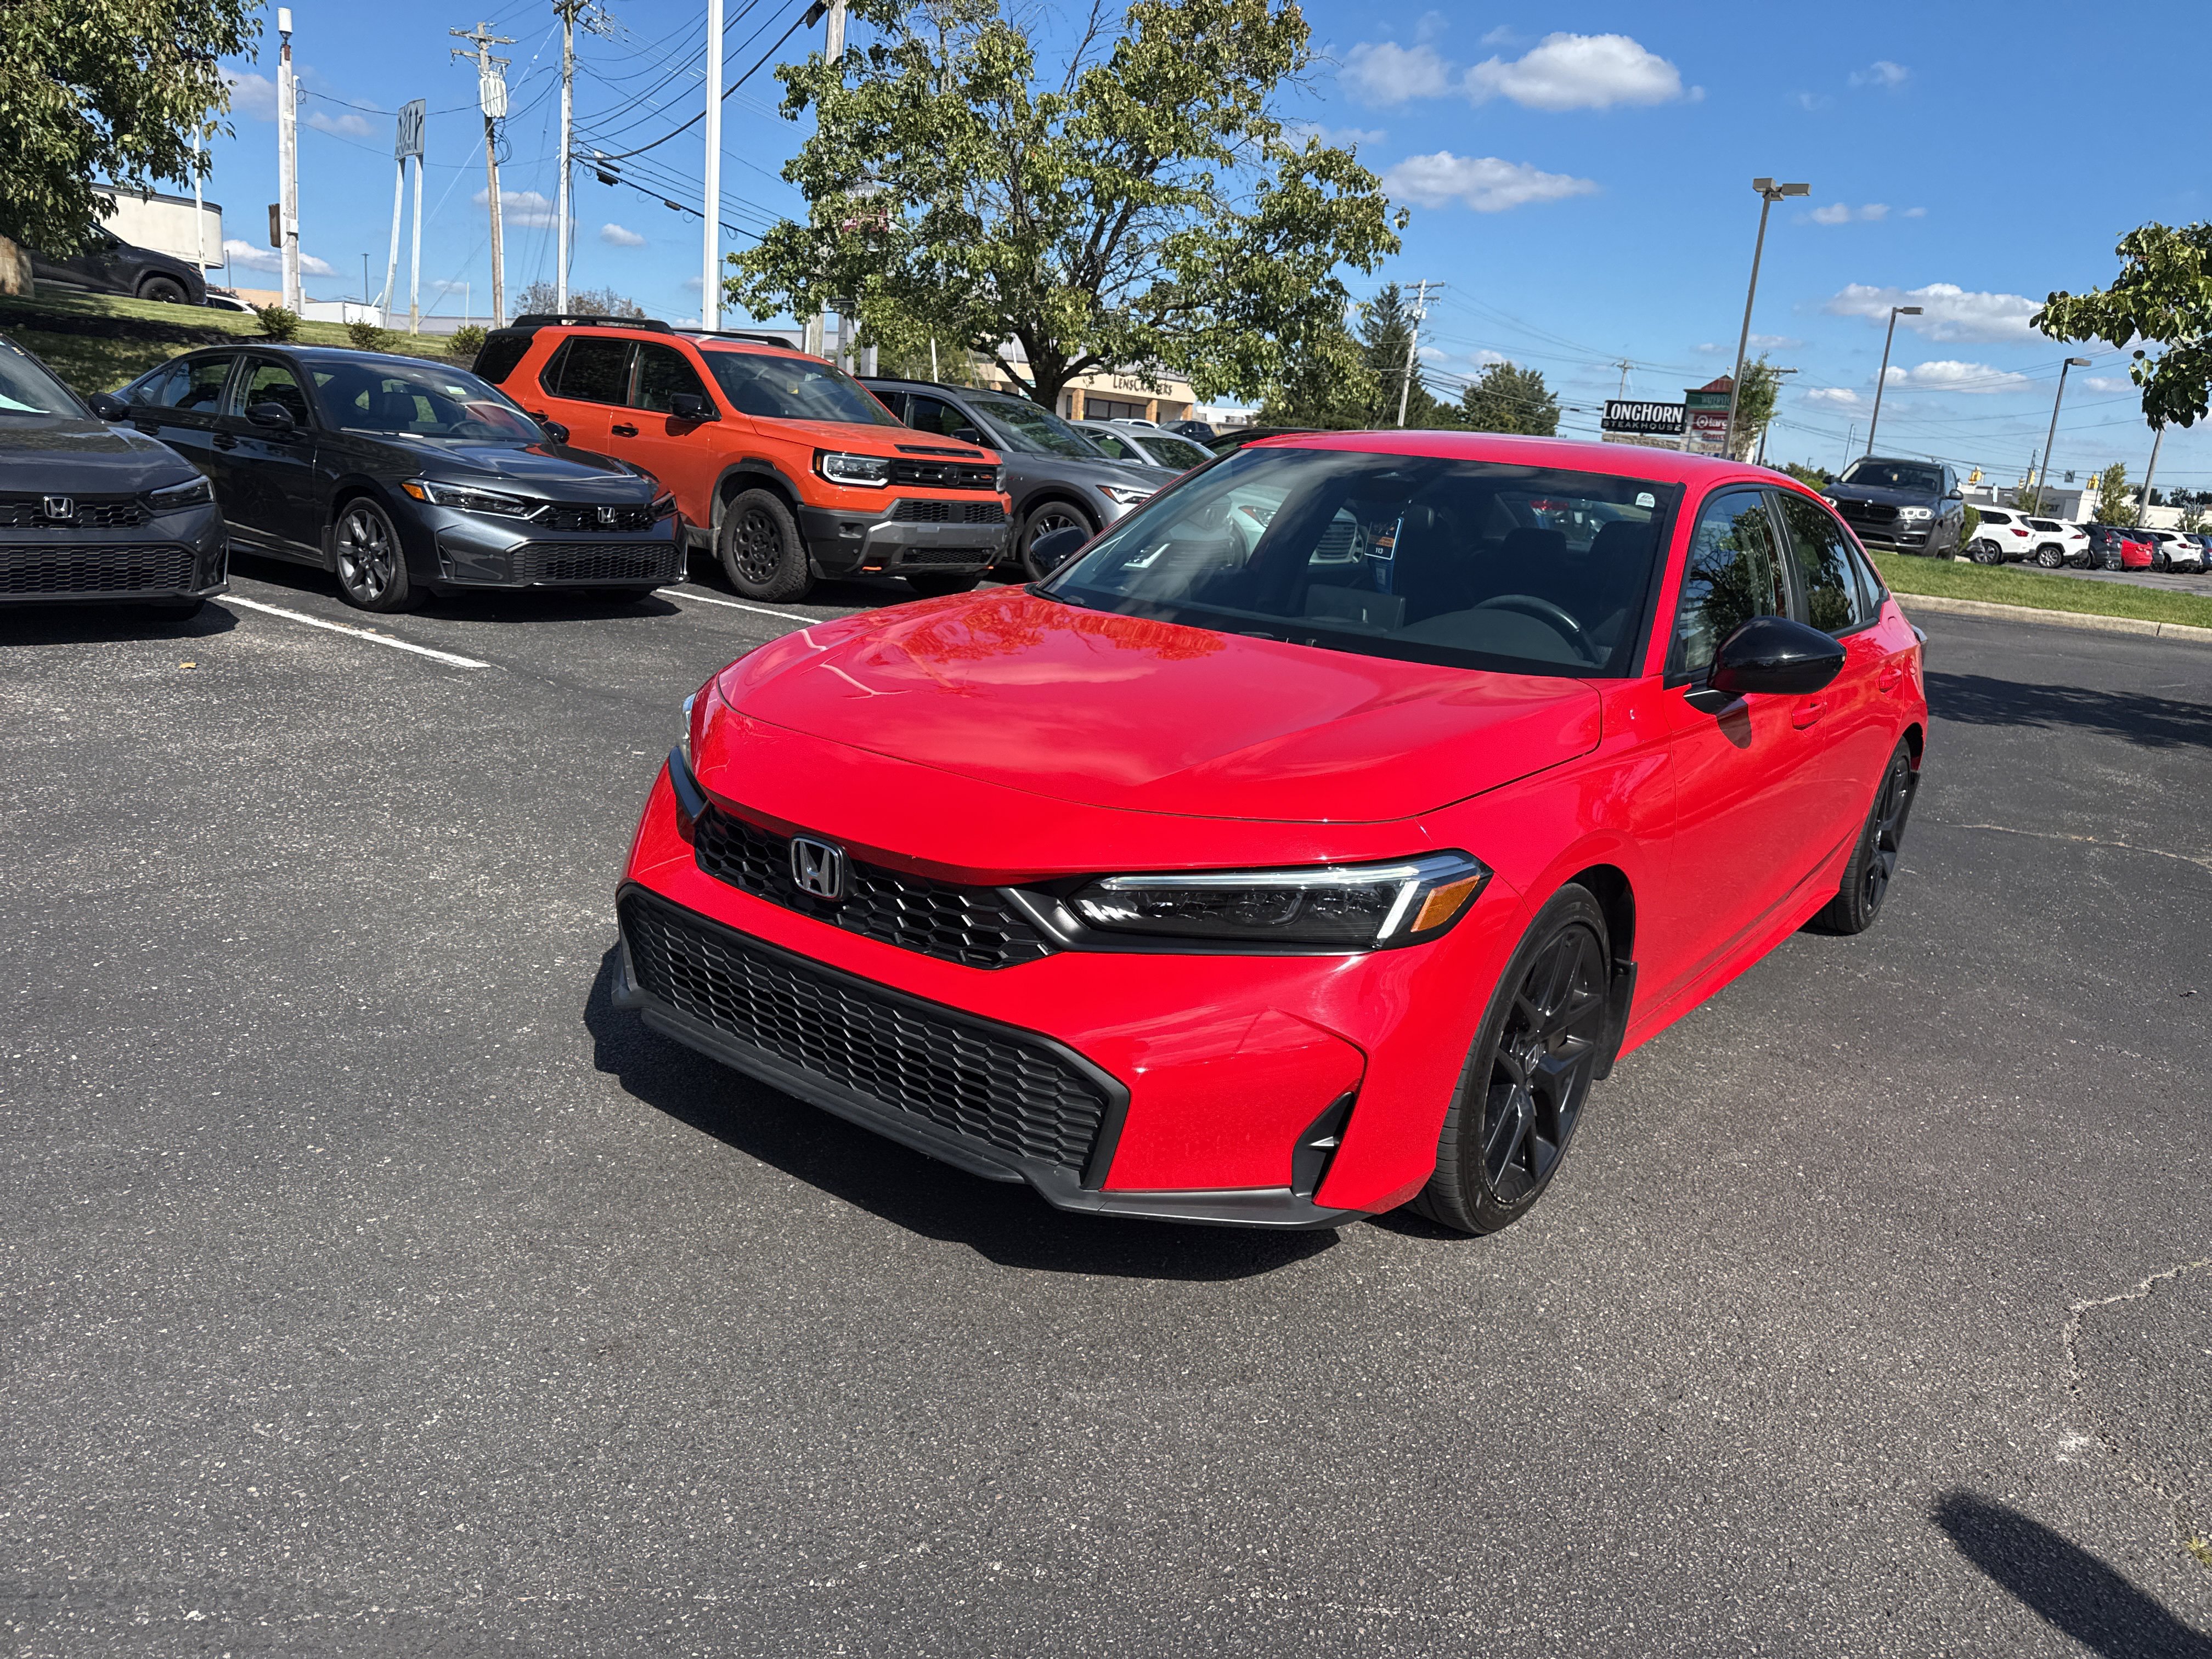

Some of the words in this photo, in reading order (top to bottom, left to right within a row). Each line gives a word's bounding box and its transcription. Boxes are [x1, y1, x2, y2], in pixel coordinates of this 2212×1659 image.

[1602, 402, 1684, 424] LONGHORN
[1603, 420, 1682, 432] STEAKHOUSE
[1708, 417, 1728, 430] targ
